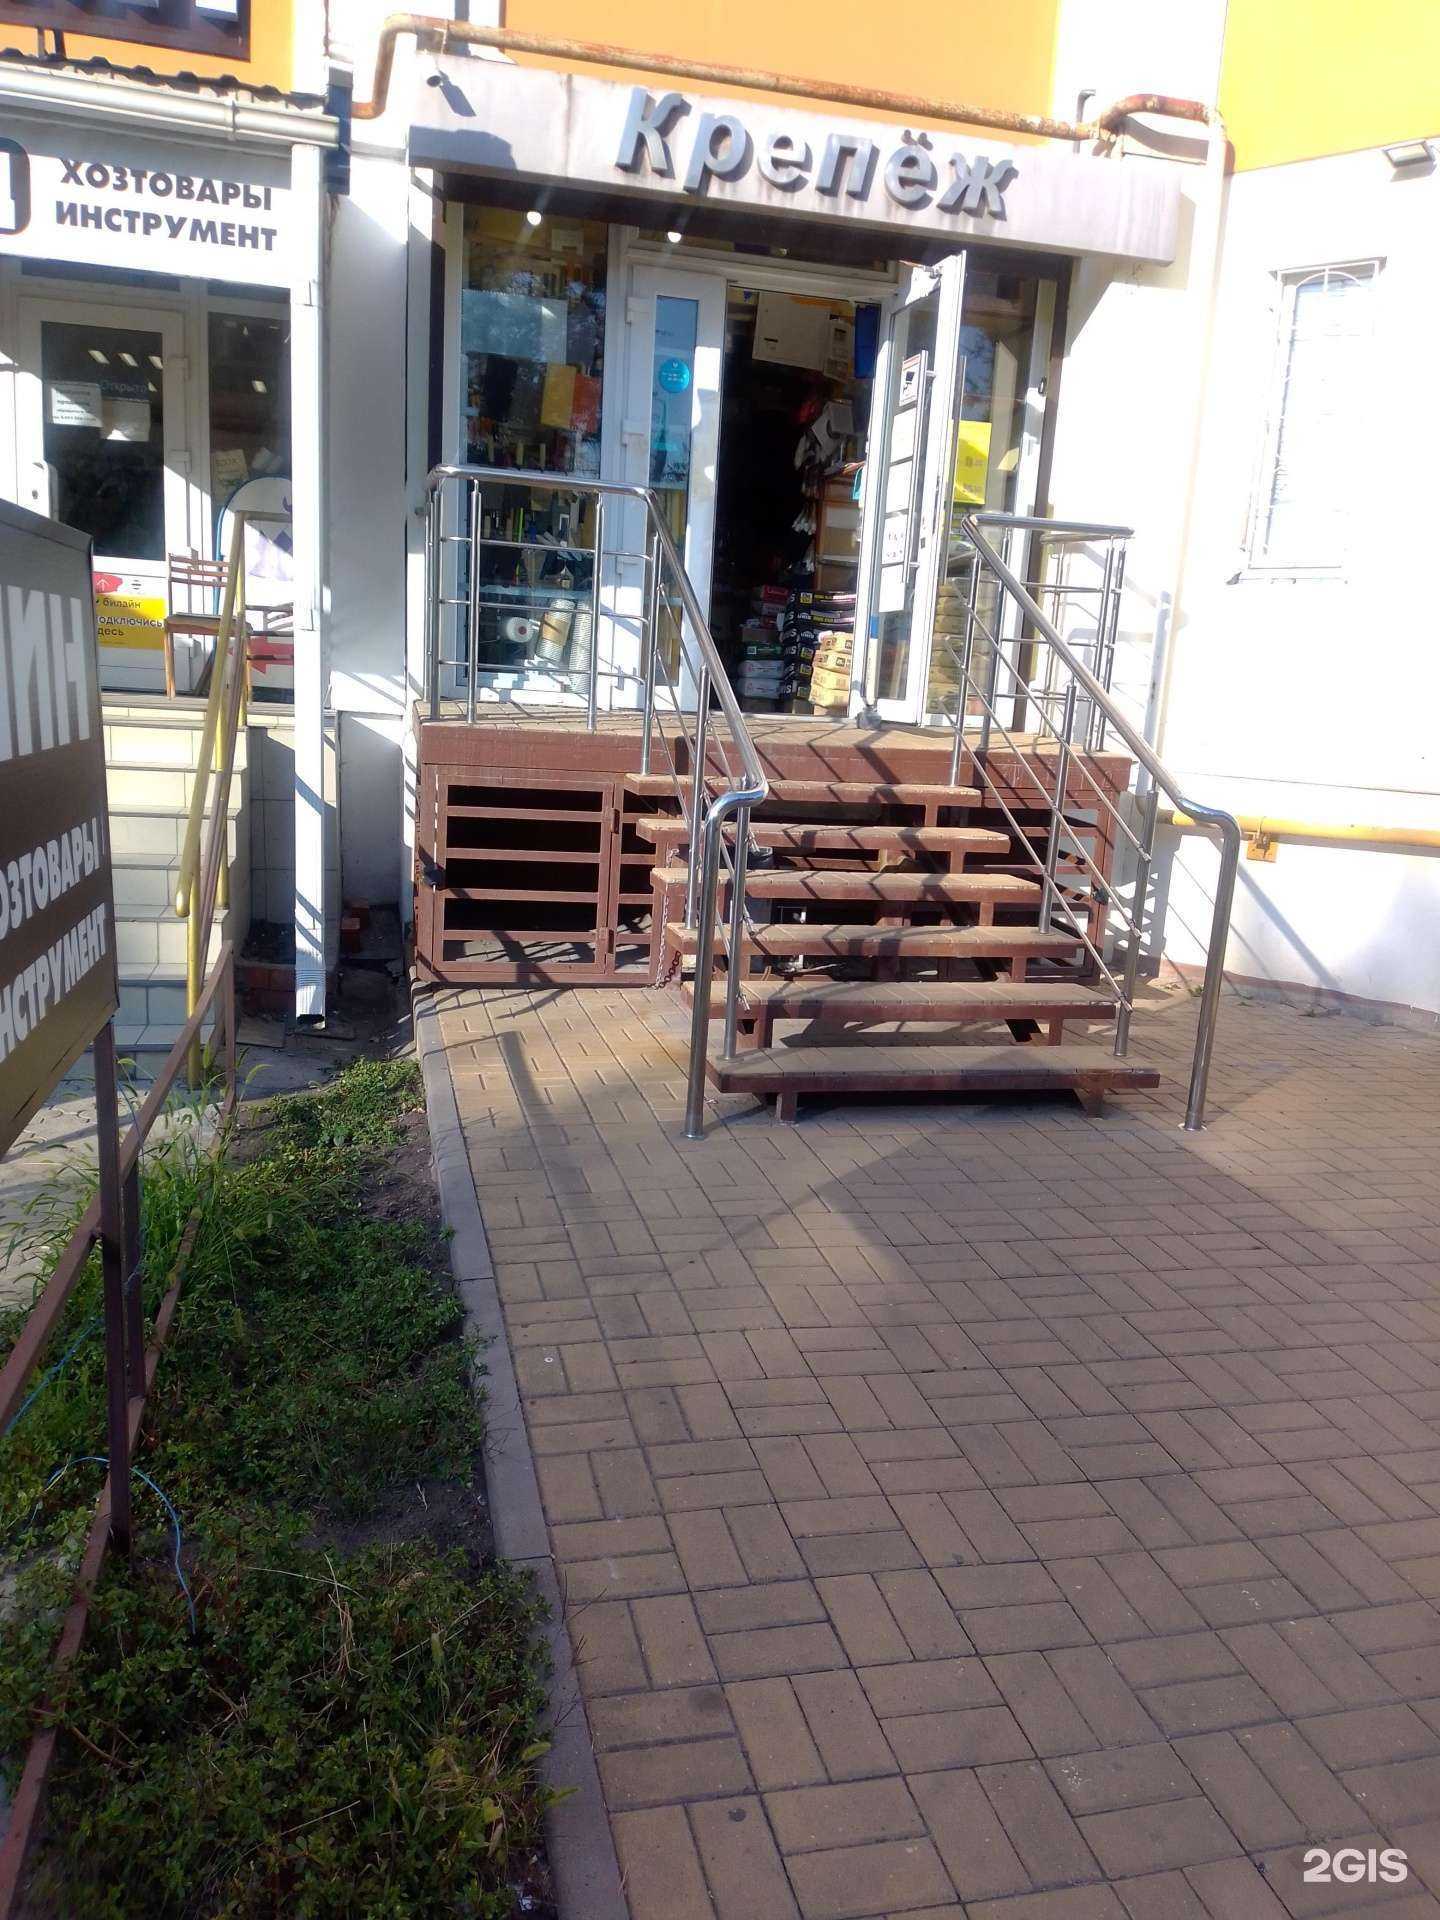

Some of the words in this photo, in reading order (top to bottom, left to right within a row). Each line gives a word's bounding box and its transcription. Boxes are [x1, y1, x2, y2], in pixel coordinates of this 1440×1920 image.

[615, 86, 1019, 221] Крепёж
[60, 157, 272, 211] ХОЗТОВАРЫ
[56, 200, 278, 251] ИНСТРУМЕНТ
[96, 615, 163, 628] одключись
